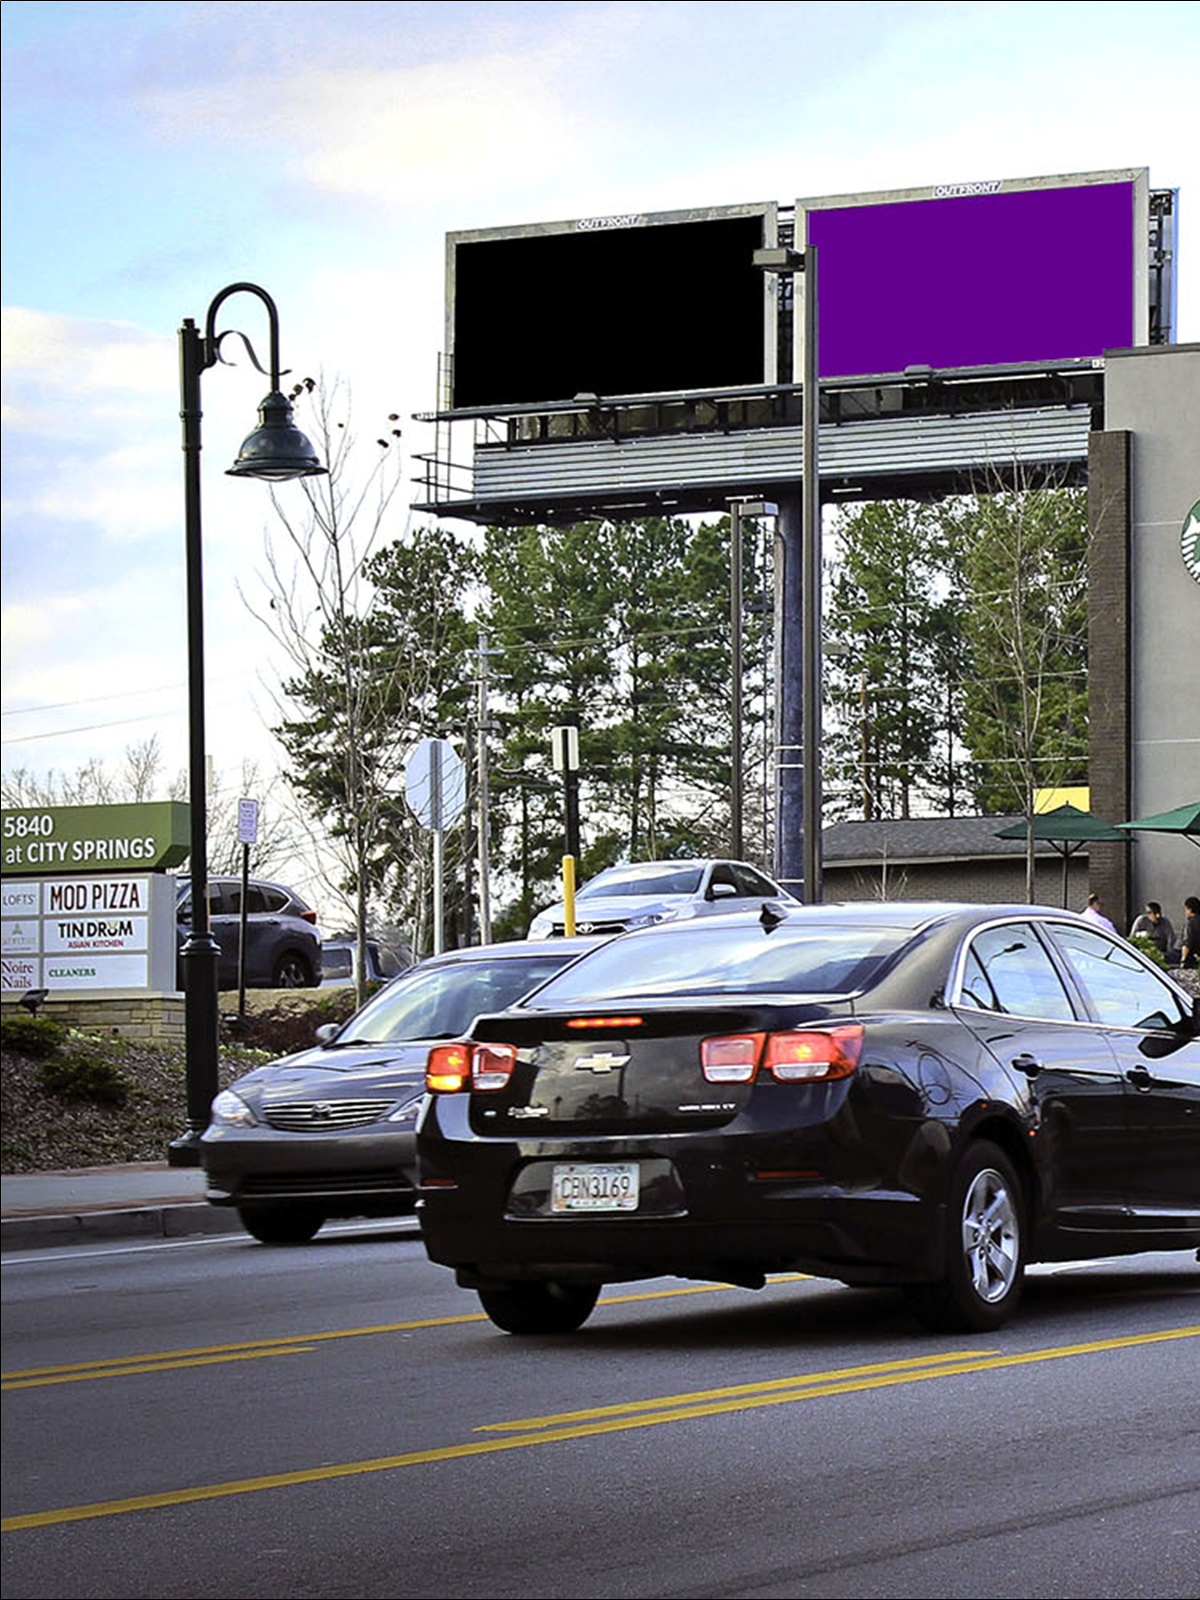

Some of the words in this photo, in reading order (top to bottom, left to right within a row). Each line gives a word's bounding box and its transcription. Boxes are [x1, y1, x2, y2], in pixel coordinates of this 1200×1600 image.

[3, 815, 54, 838] 5840
[5, 845, 23, 864] at
[27, 842, 68, 863] CITY
[72, 837, 156, 861] SPRINGS
[3, 894, 36, 906] LOFTS
[50, 884, 88, 911] MOD
[92, 882, 140, 910] PIZZA
[1, 961, 34, 974] Noire
[49, 968, 96, 978] CLEANERS
[1, 976, 33, 989] Nails
[560, 1175, 630, 1199] CBN3169
